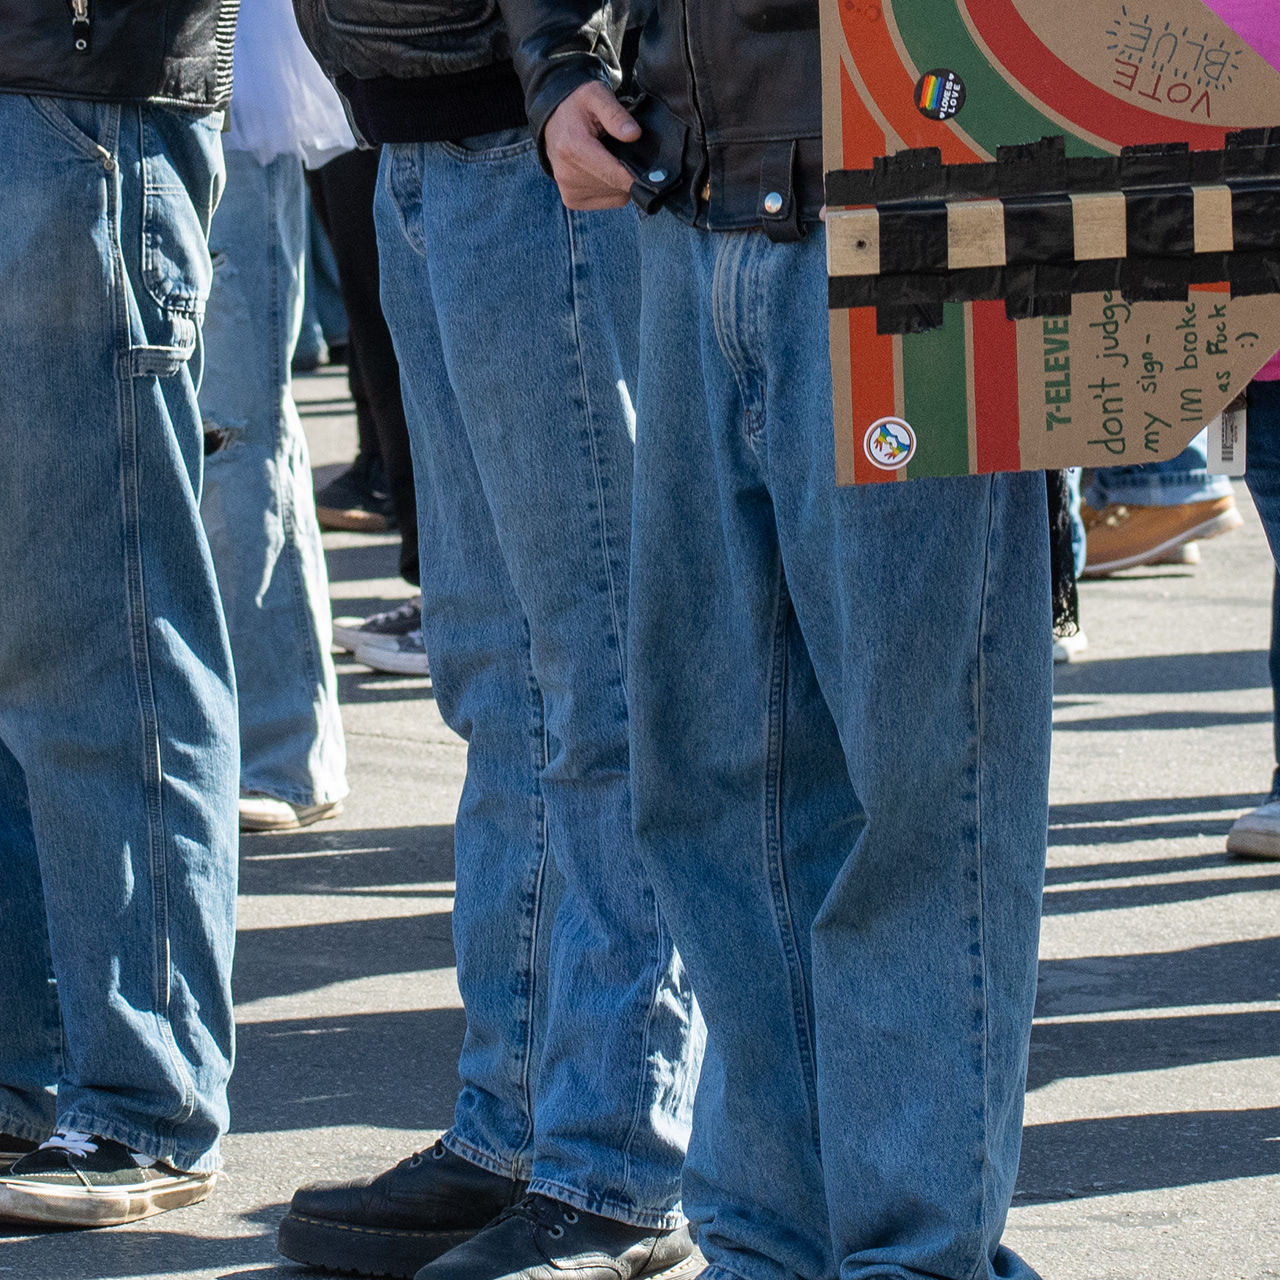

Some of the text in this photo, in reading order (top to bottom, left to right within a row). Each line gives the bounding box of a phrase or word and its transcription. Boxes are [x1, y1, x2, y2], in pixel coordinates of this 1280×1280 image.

[1123, 21, 1231, 82] BLUE
[939, 89, 951, 112] LOVE
[948, 83, 961, 113] LOVE
[1113, 58, 1211, 119] VOTE
[1175, 302, 1199, 371] broke
[1042, 315, 1072, 432] 7-ELEVE
[1087, 290, 1131, 455] don't judge
[1216, 370, 1231, 392] as
[1144, 411, 1171, 453] my
